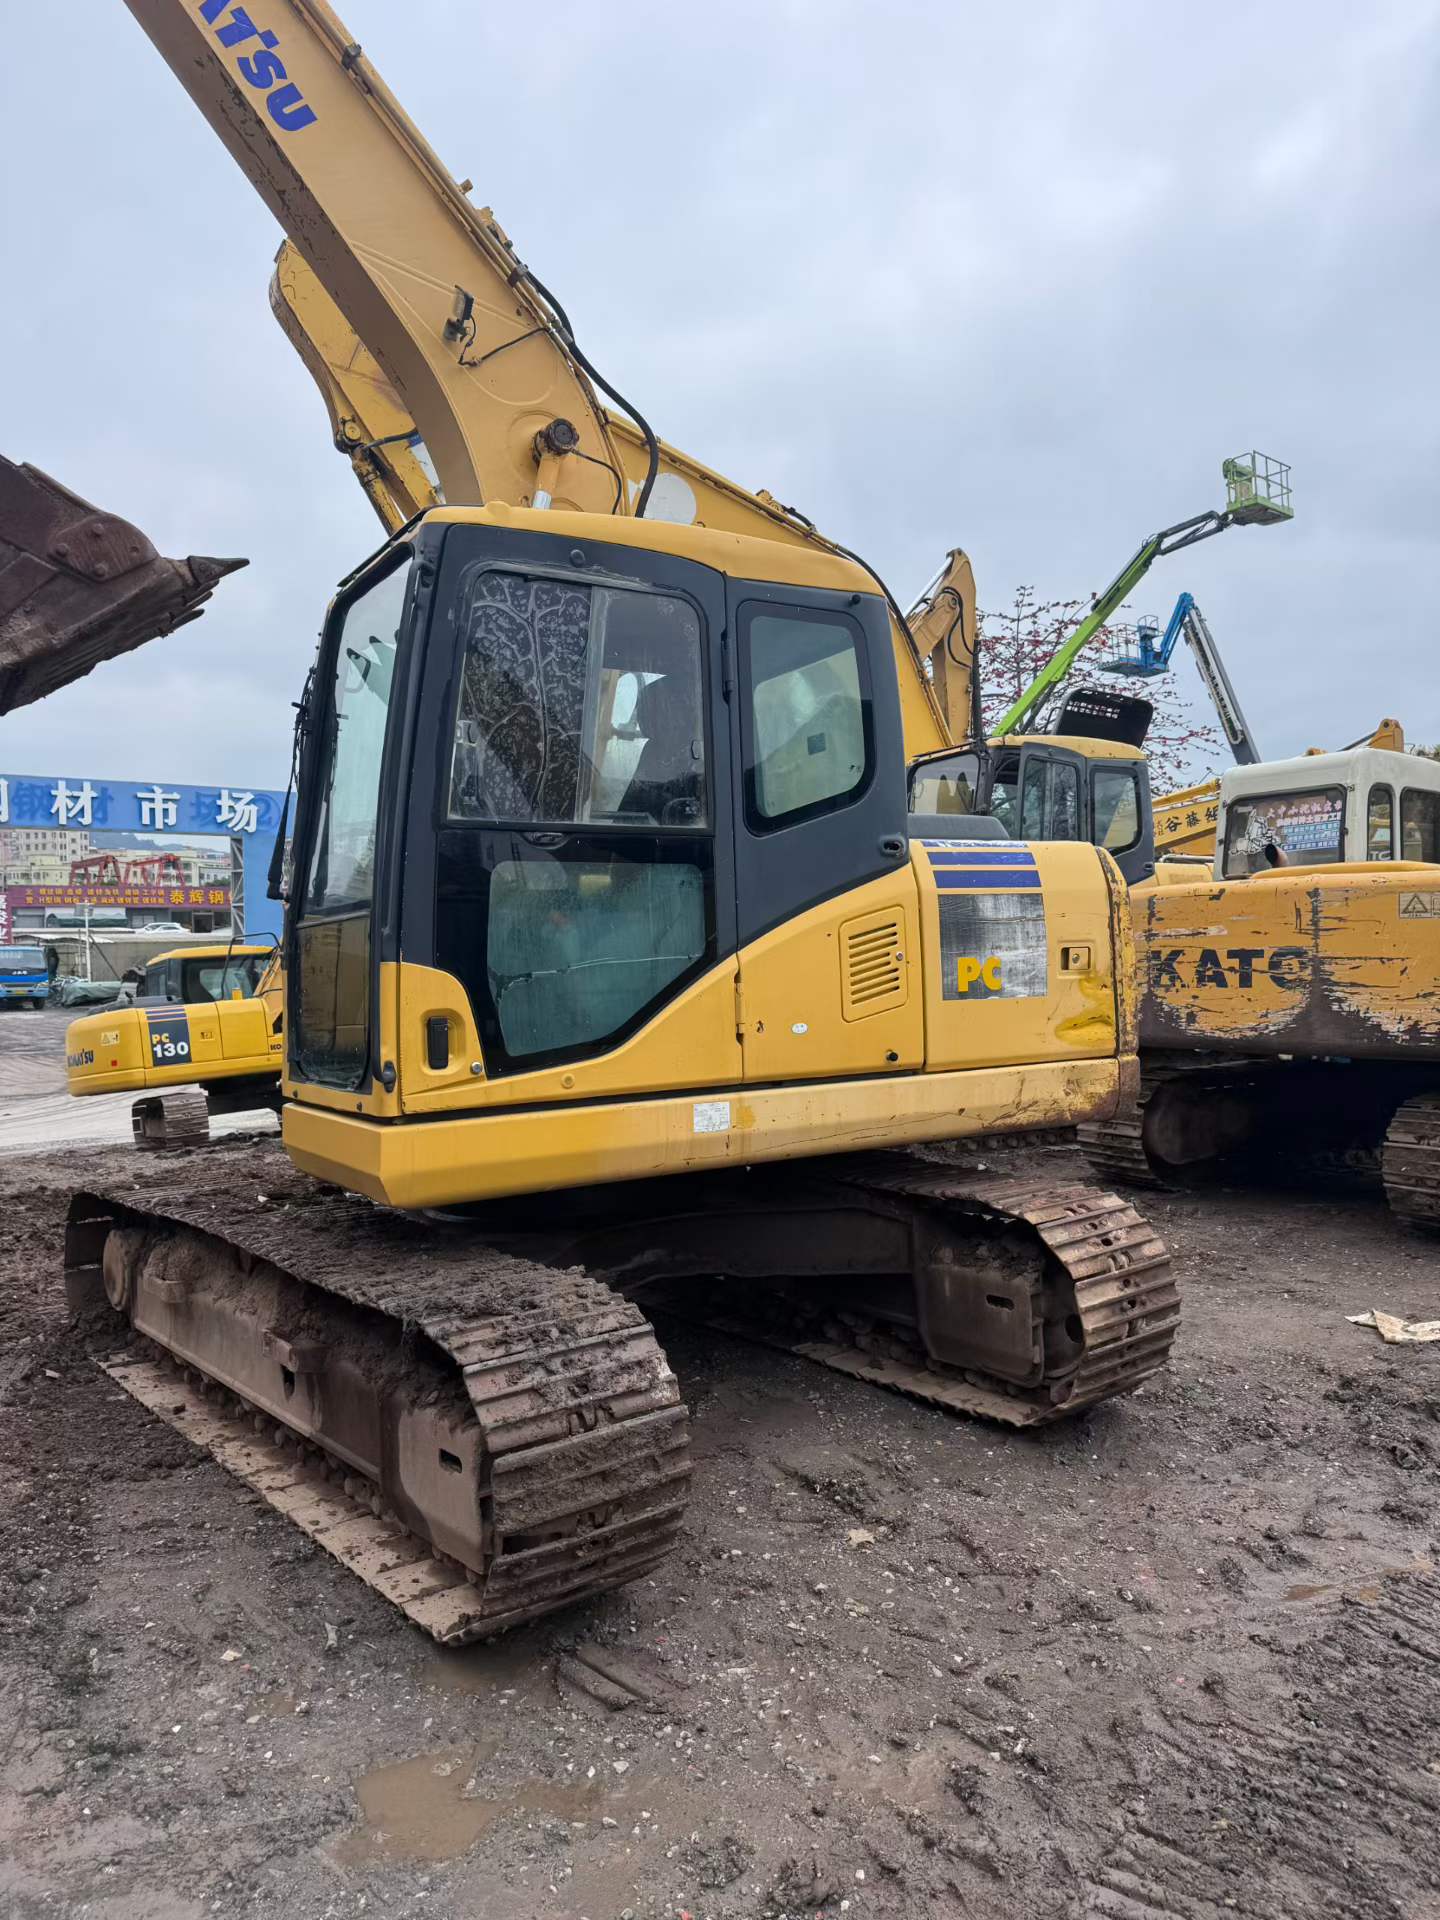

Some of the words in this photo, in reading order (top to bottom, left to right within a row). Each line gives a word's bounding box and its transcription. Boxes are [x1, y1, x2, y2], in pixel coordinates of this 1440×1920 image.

[169, 889, 231, 905] 泰辉钢
[957, 956, 1002, 993] PC
[1150, 946, 1309, 990] KATO
[152, 1033, 170, 1045] PC
[153, 1041, 189, 1058] 130
